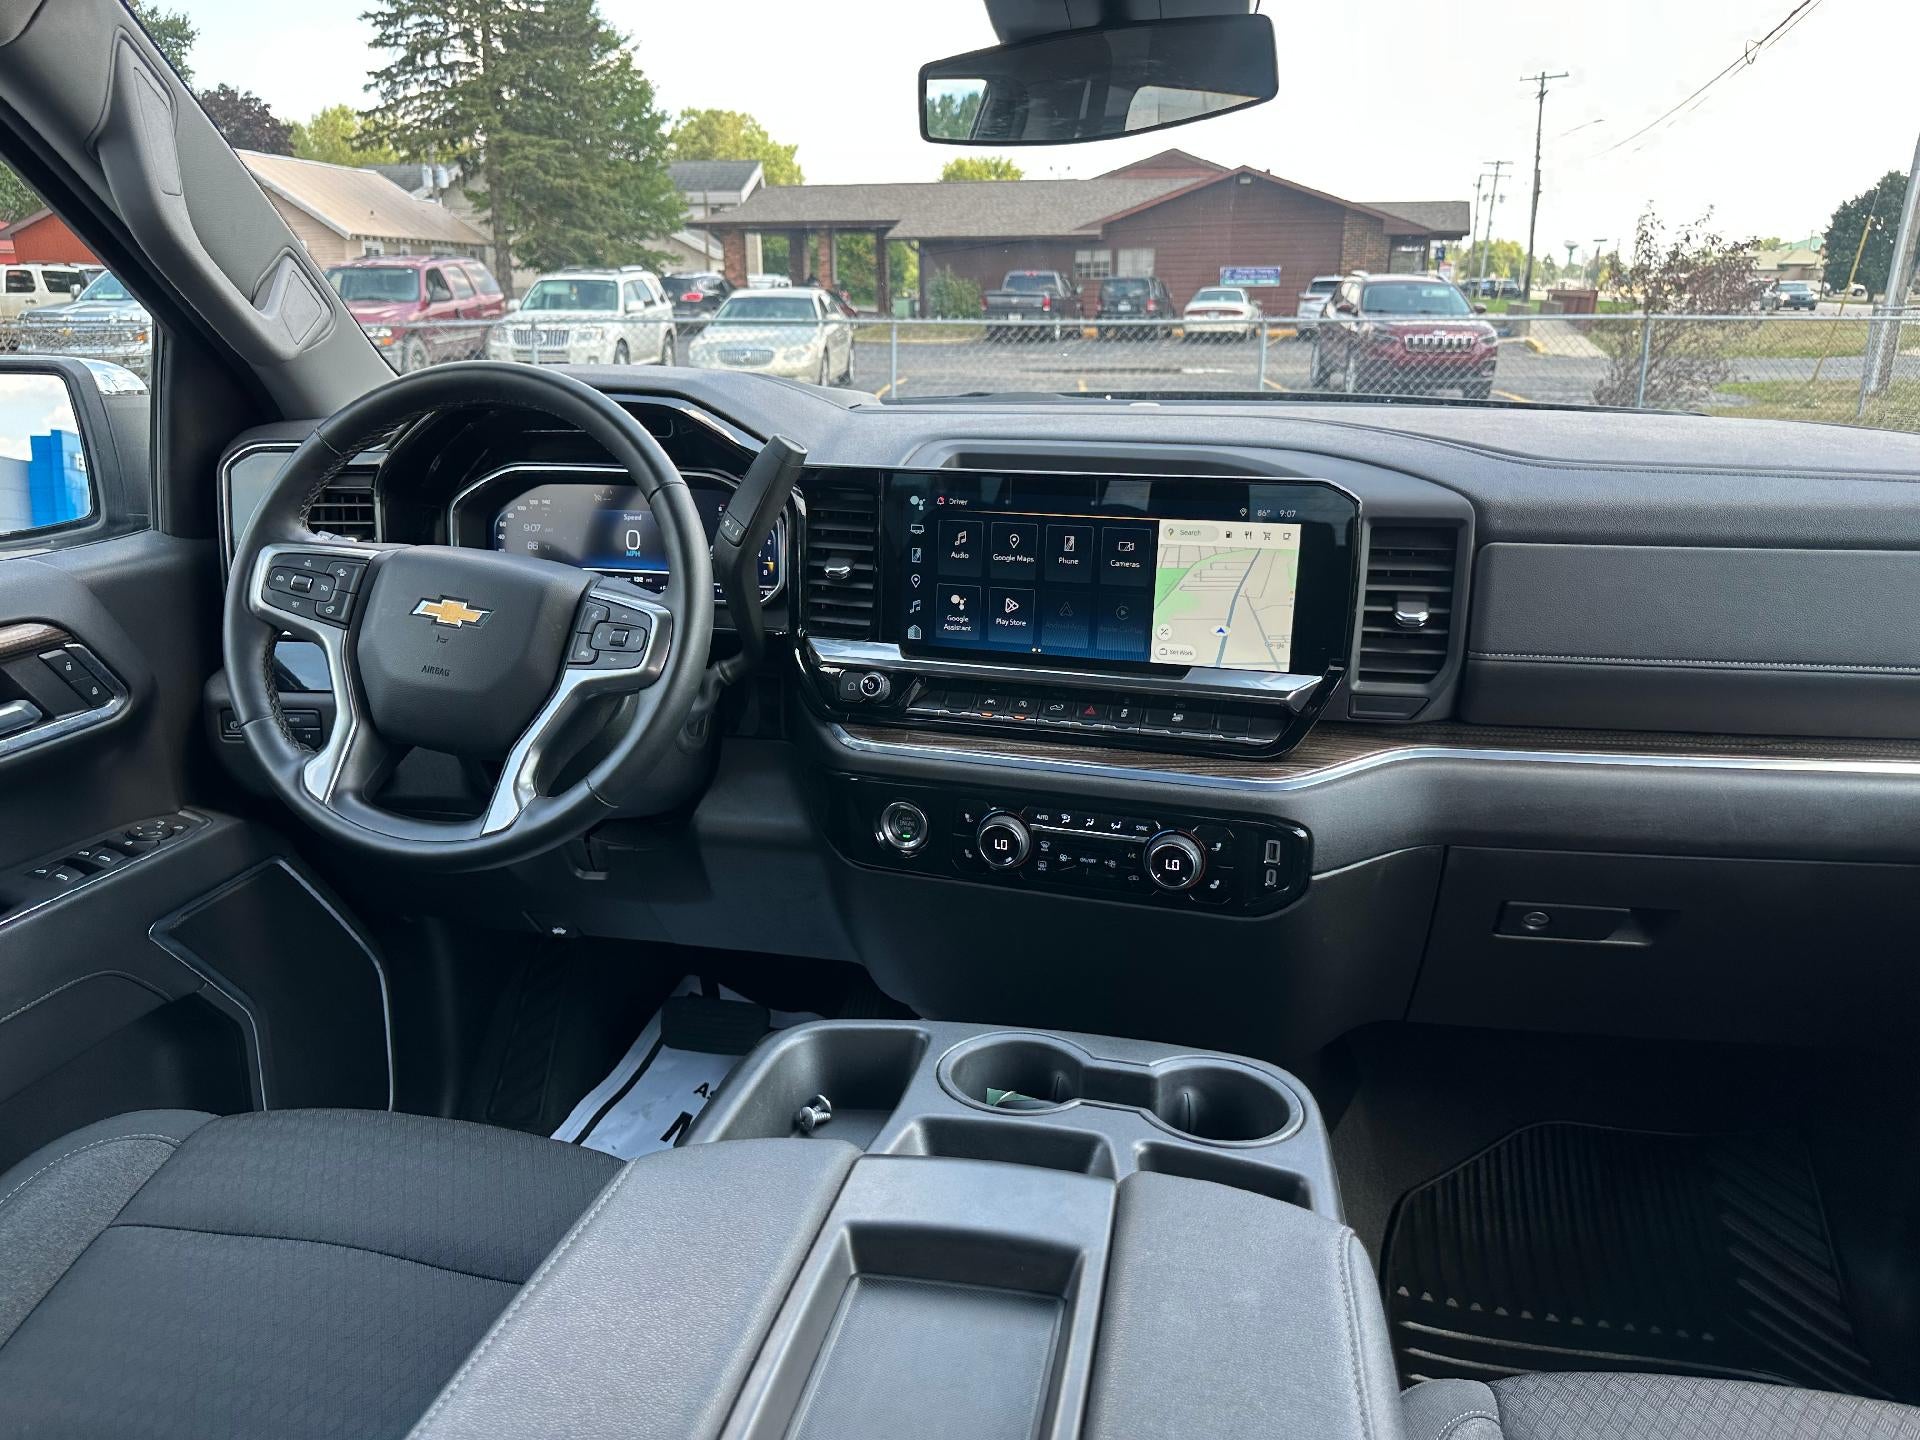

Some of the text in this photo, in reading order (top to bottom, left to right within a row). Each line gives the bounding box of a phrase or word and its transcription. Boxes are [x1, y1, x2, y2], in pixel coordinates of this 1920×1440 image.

[949, 497, 968, 506] Driver
[623, 513, 642, 521] Speed
[1279, 509, 1297, 518] 9:07
[1179, 529, 1201, 537] Search
[625, 529, 641, 551] 0
[950, 551, 970, 559] Audio
[992, 553, 1035, 563] Google Maps
[1058, 556, 1079, 565] Phone
[1110, 559, 1141, 568] Cameras
[946, 614, 969, 623] Google
[995, 617, 1027, 627] Play Store
[943, 623, 972, 631] Assistant
[421, 665, 450, 677] AIRBAG
[1036, 813, 1049, 821] AUTO
